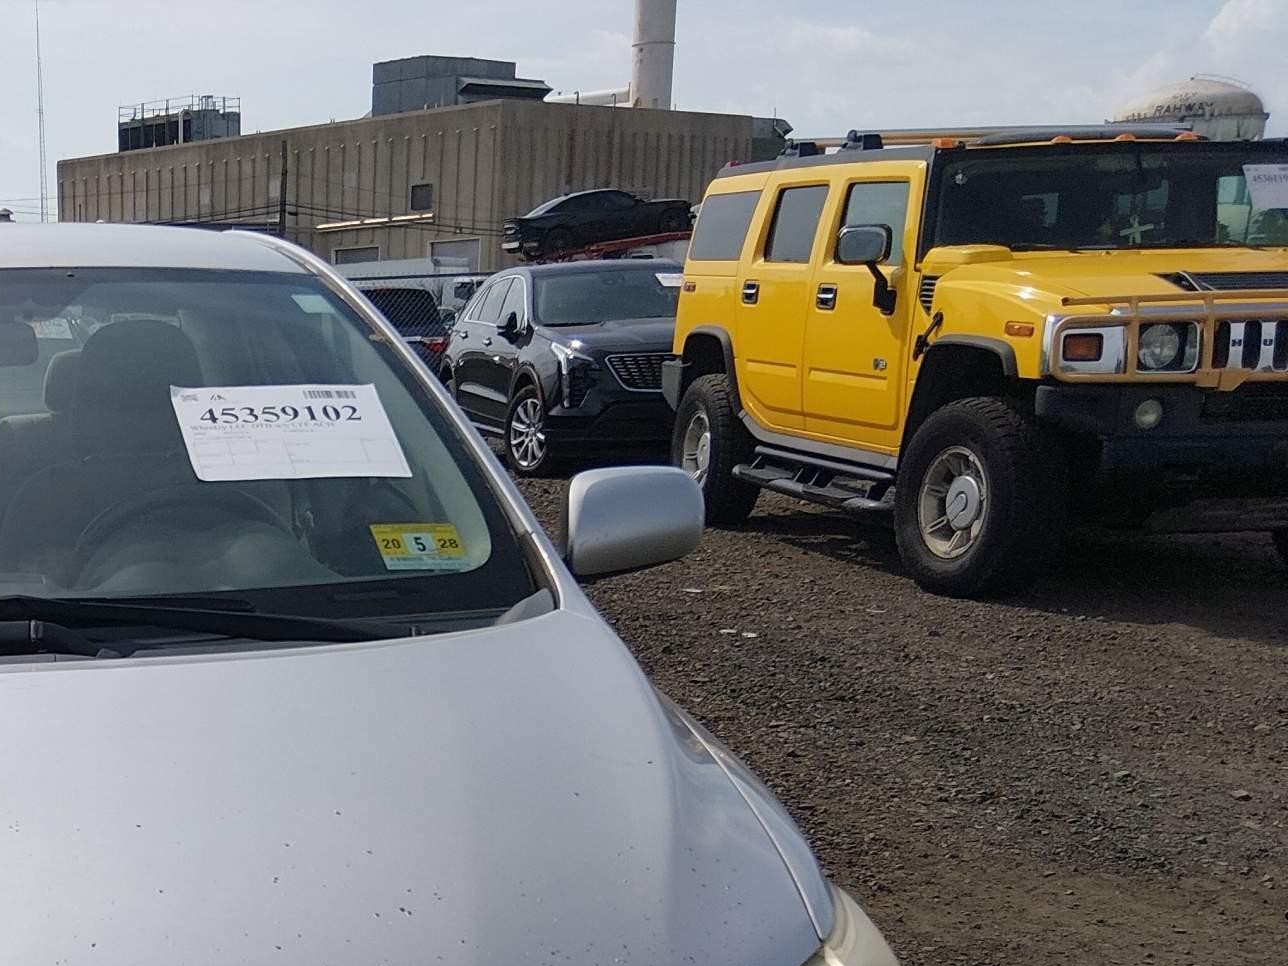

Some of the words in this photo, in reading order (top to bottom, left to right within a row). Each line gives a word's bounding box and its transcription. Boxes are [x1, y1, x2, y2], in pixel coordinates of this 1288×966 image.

[1154, 102, 1215, 115] RAHWAY
[199, 404, 362, 424] 45359102
[381, 538, 401, 549] 20
[413, 536, 427, 552] 5
[437, 538, 459, 549] 28
